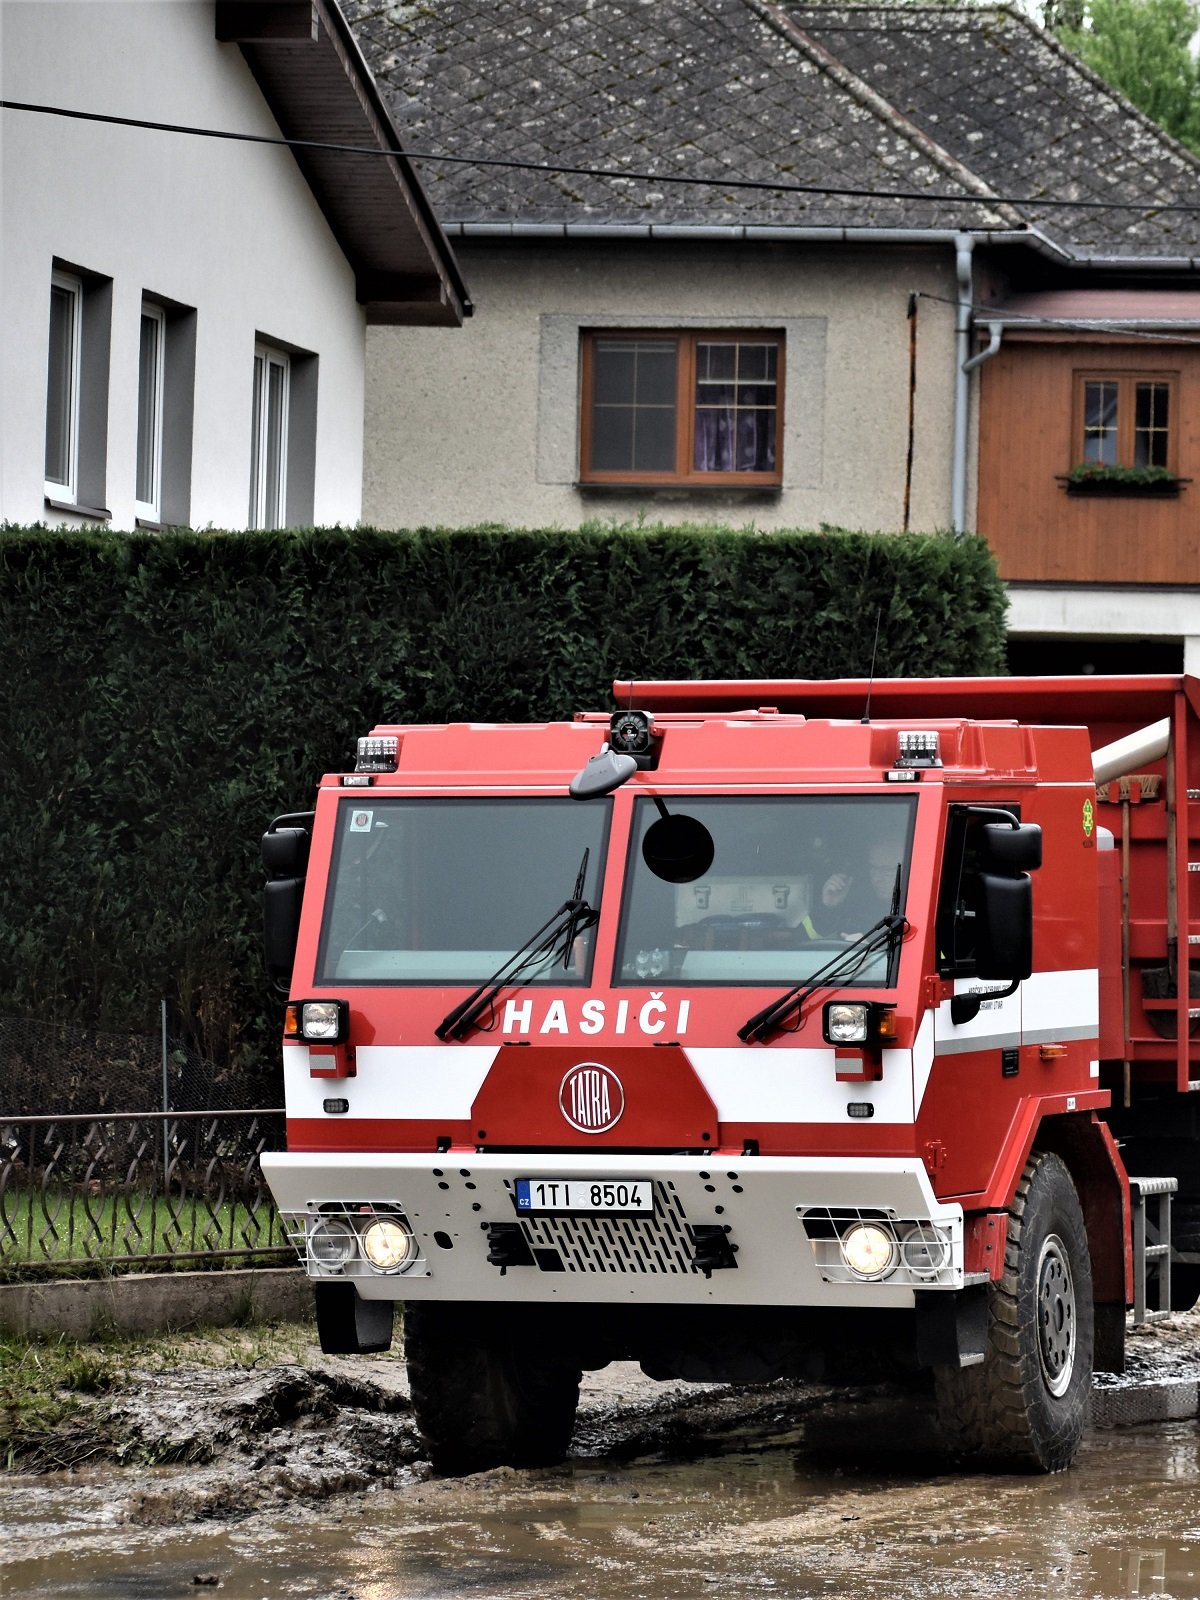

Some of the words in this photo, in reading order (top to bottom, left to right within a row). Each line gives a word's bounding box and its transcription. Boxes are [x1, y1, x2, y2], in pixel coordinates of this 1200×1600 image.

[502, 991, 690, 1034] HASIČI
[569, 1069, 611, 1127] TATRA
[519, 1198, 530, 1206] CZ
[590, 1185, 642, 1207] 8504
